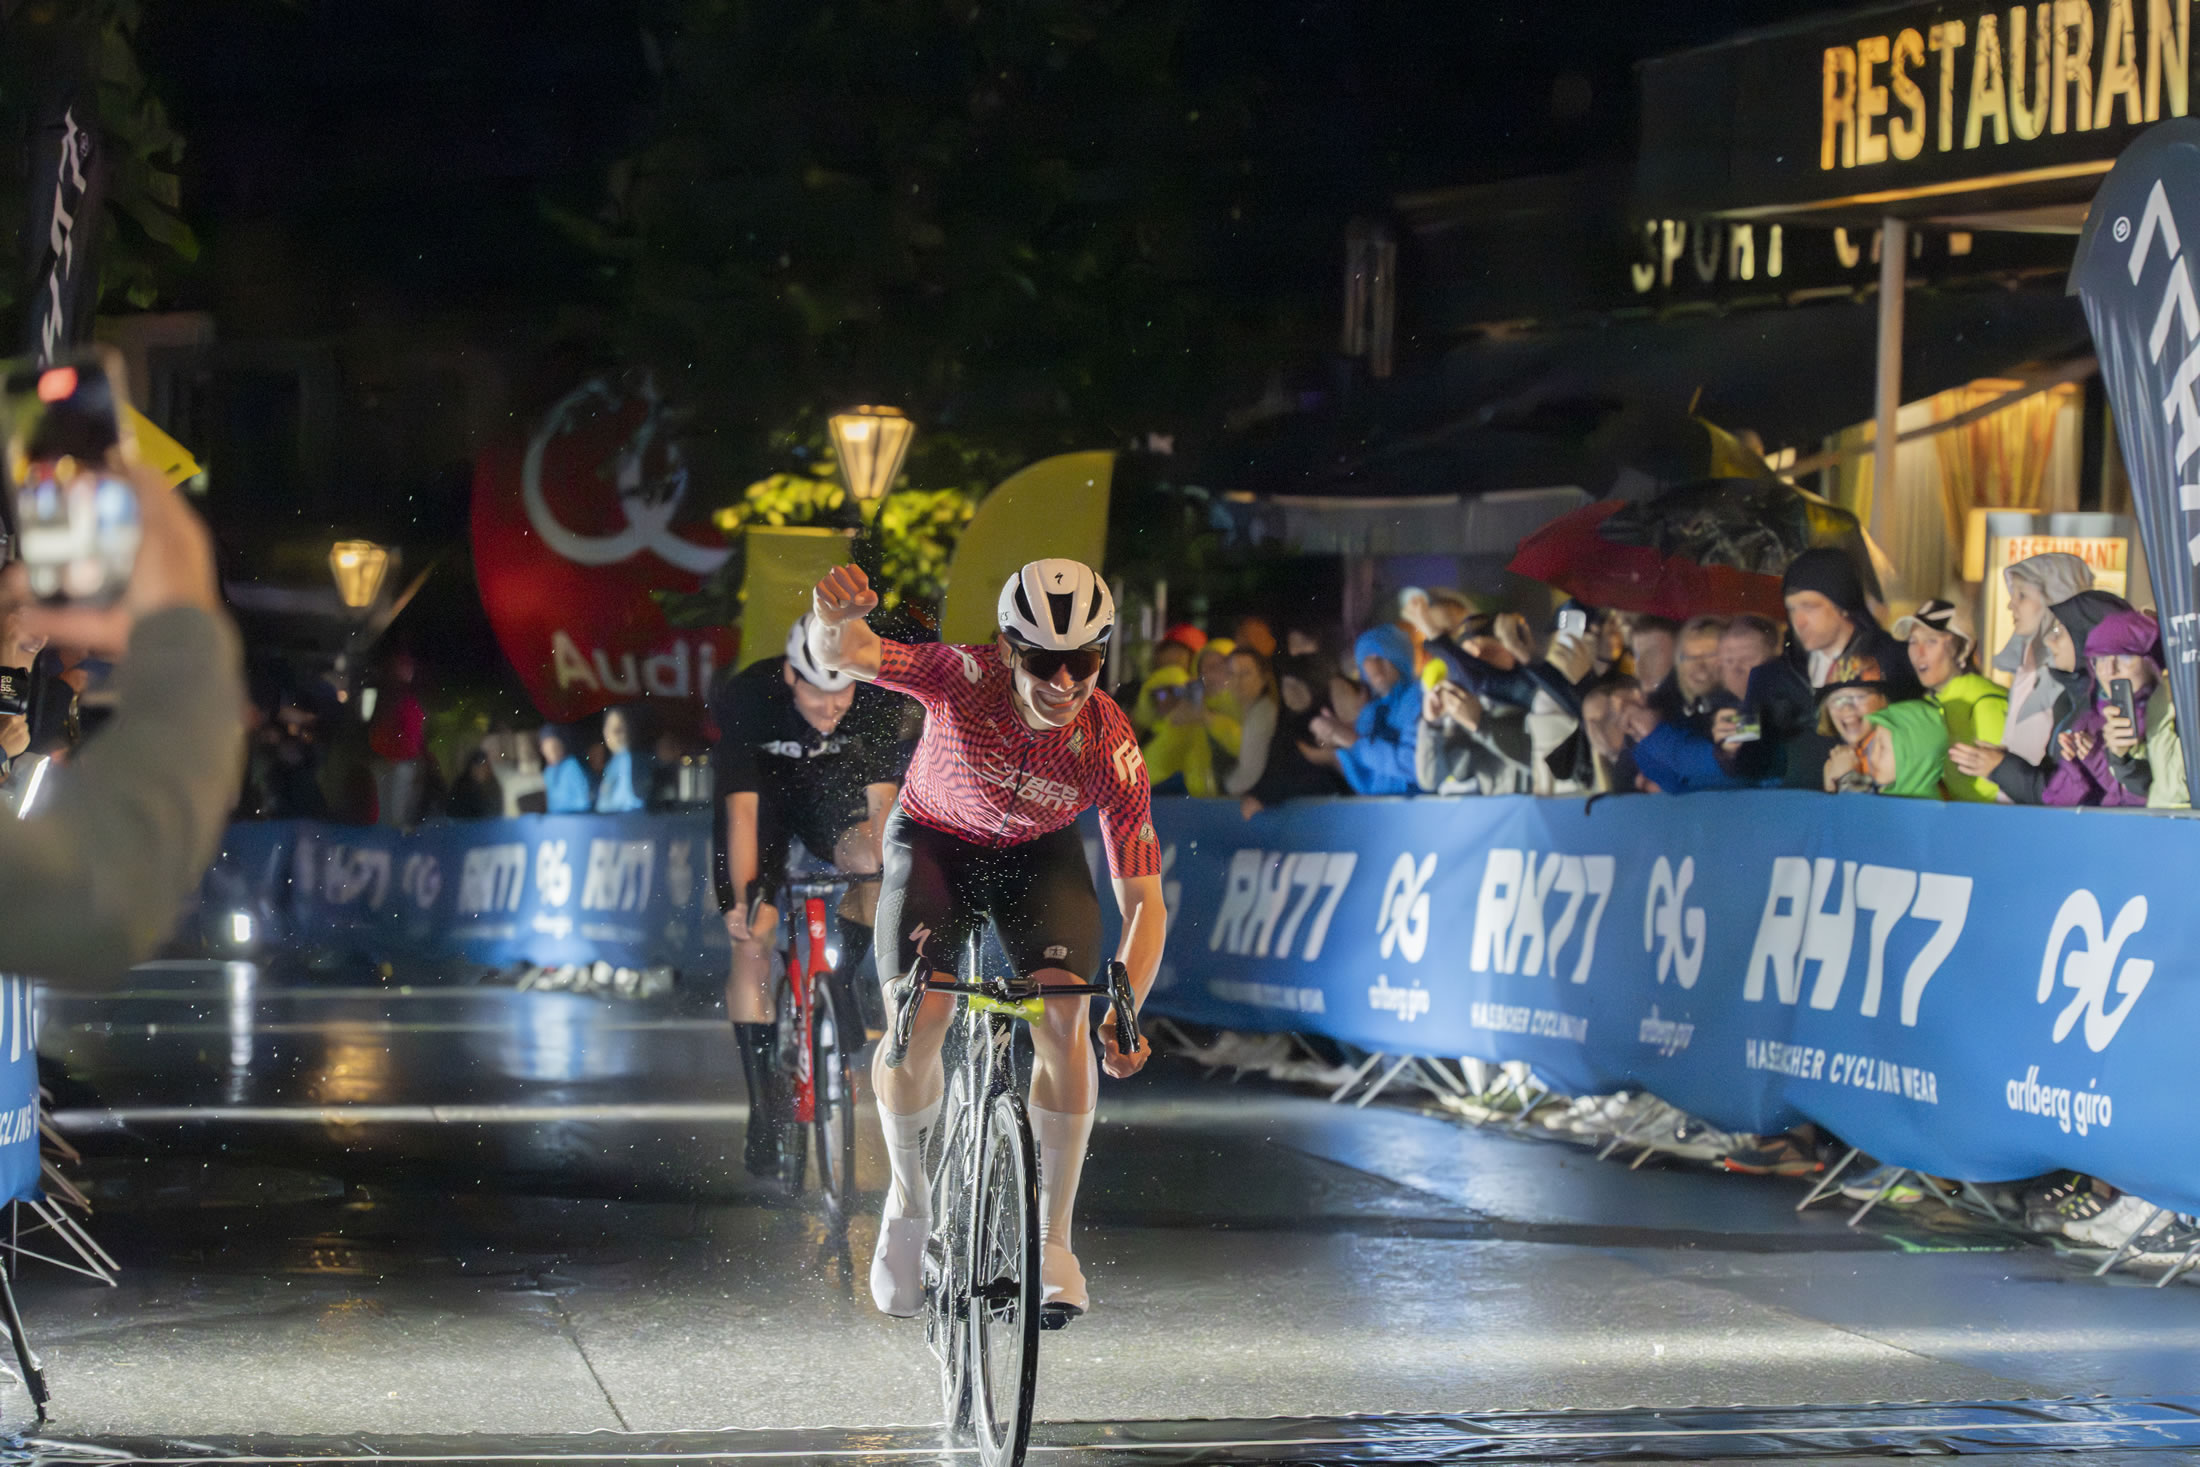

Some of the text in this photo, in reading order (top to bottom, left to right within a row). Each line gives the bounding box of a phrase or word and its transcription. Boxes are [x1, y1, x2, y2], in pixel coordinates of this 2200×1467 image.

[551, 629, 714, 699] Audi
[1210, 848, 1358, 962] RH77
[1469, 848, 1616, 985] RH77
[1743, 856, 1974, 1027] RH77
[1829, 1052, 1901, 1095] CYCLING
[1901, 1065, 1939, 1105] WEAR
[2006, 1064, 2112, 1137] arlberg giro
